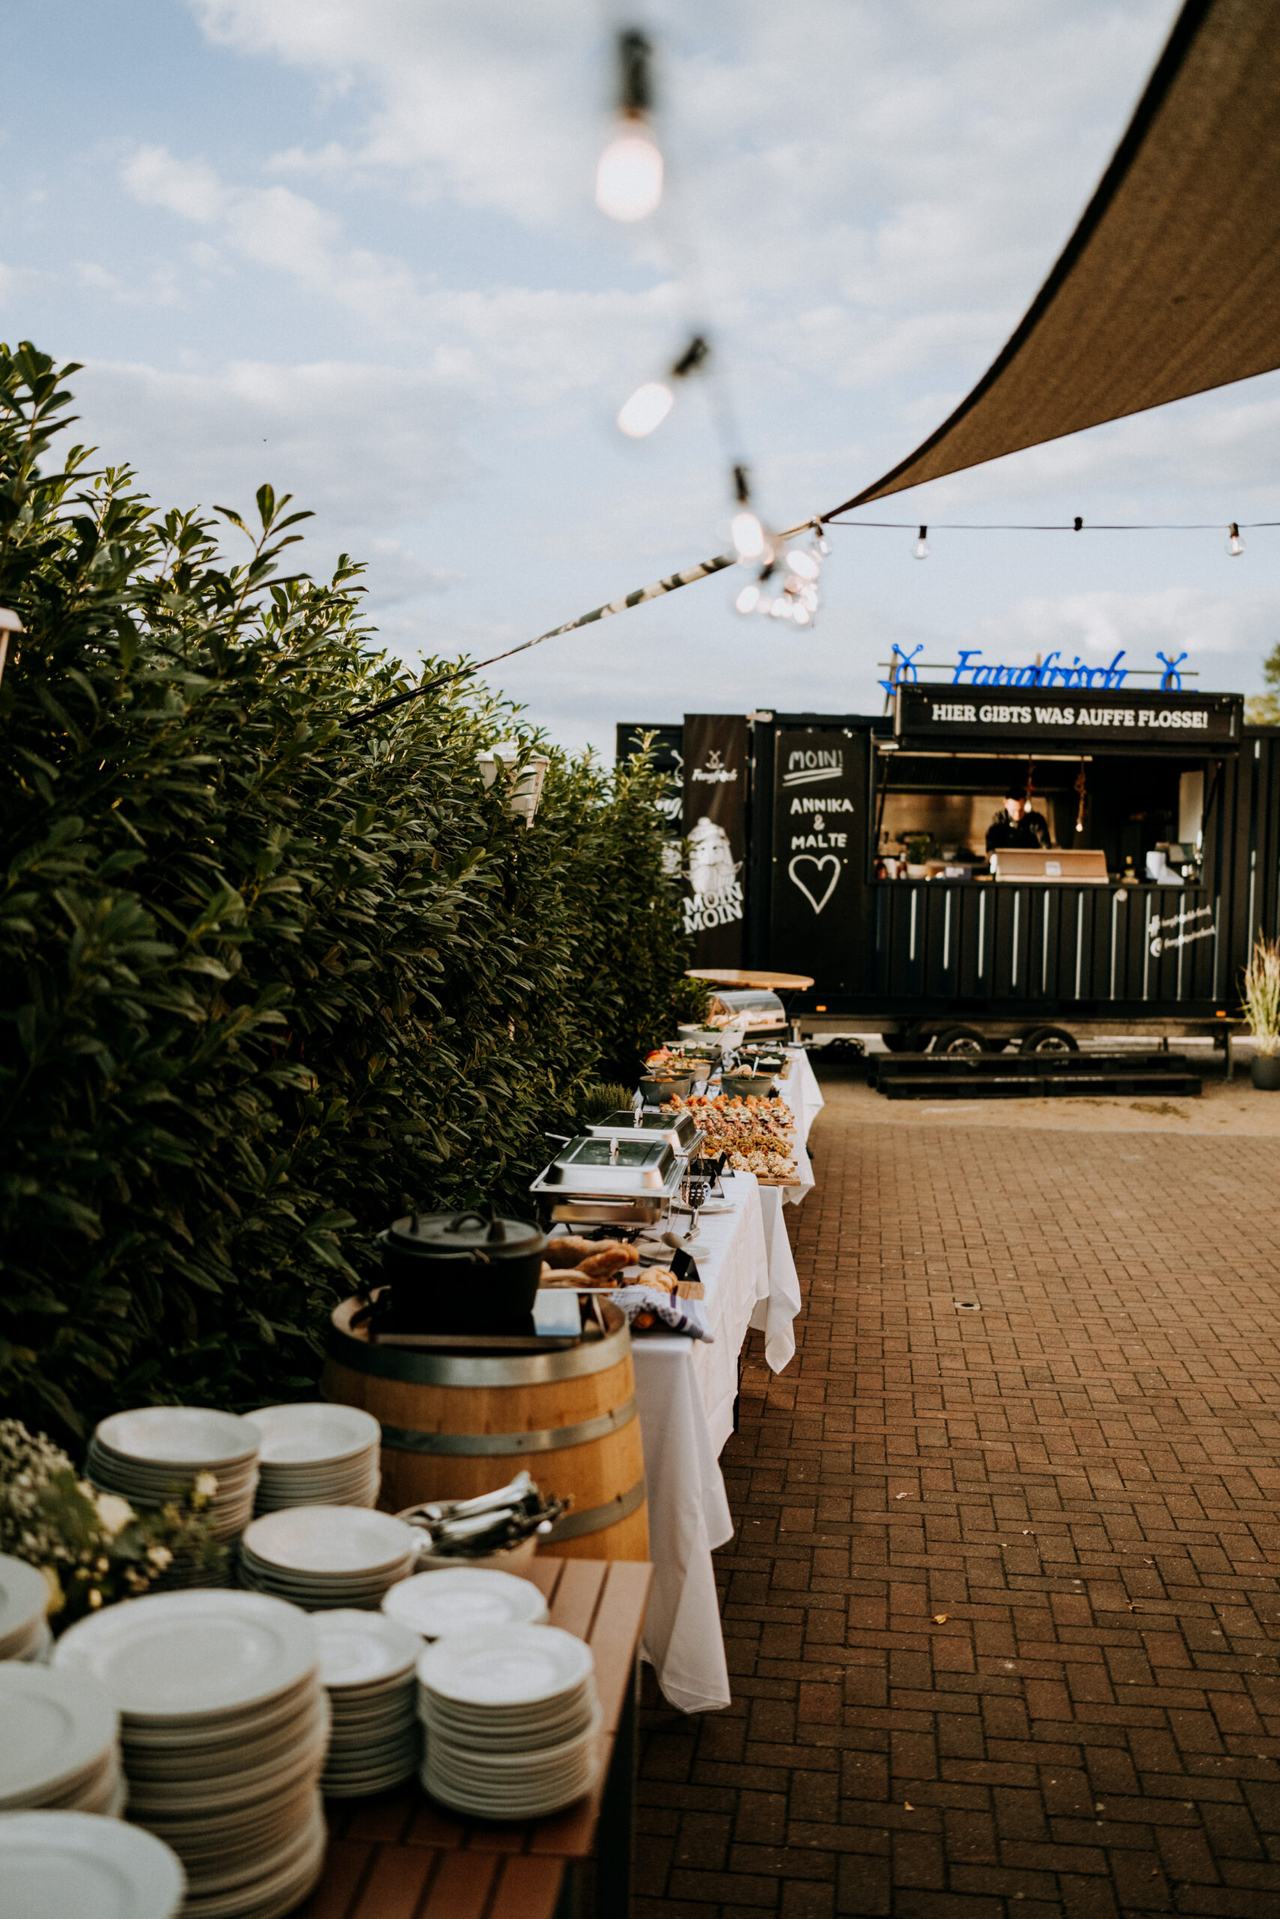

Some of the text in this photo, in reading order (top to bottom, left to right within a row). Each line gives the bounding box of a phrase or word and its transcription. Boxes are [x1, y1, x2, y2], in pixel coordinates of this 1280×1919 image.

[932, 704, 1208, 729] HIER GIBTS WAS AUFFE FLOSSE!
[789, 749, 844, 770] MOIN!
[790, 798, 854, 815] ANNIKA
[813, 814, 825, 831] &
[791, 833, 848, 850] MALTE
[682, 881, 744, 915] MOIN
[682, 902, 744, 935] MOIN
